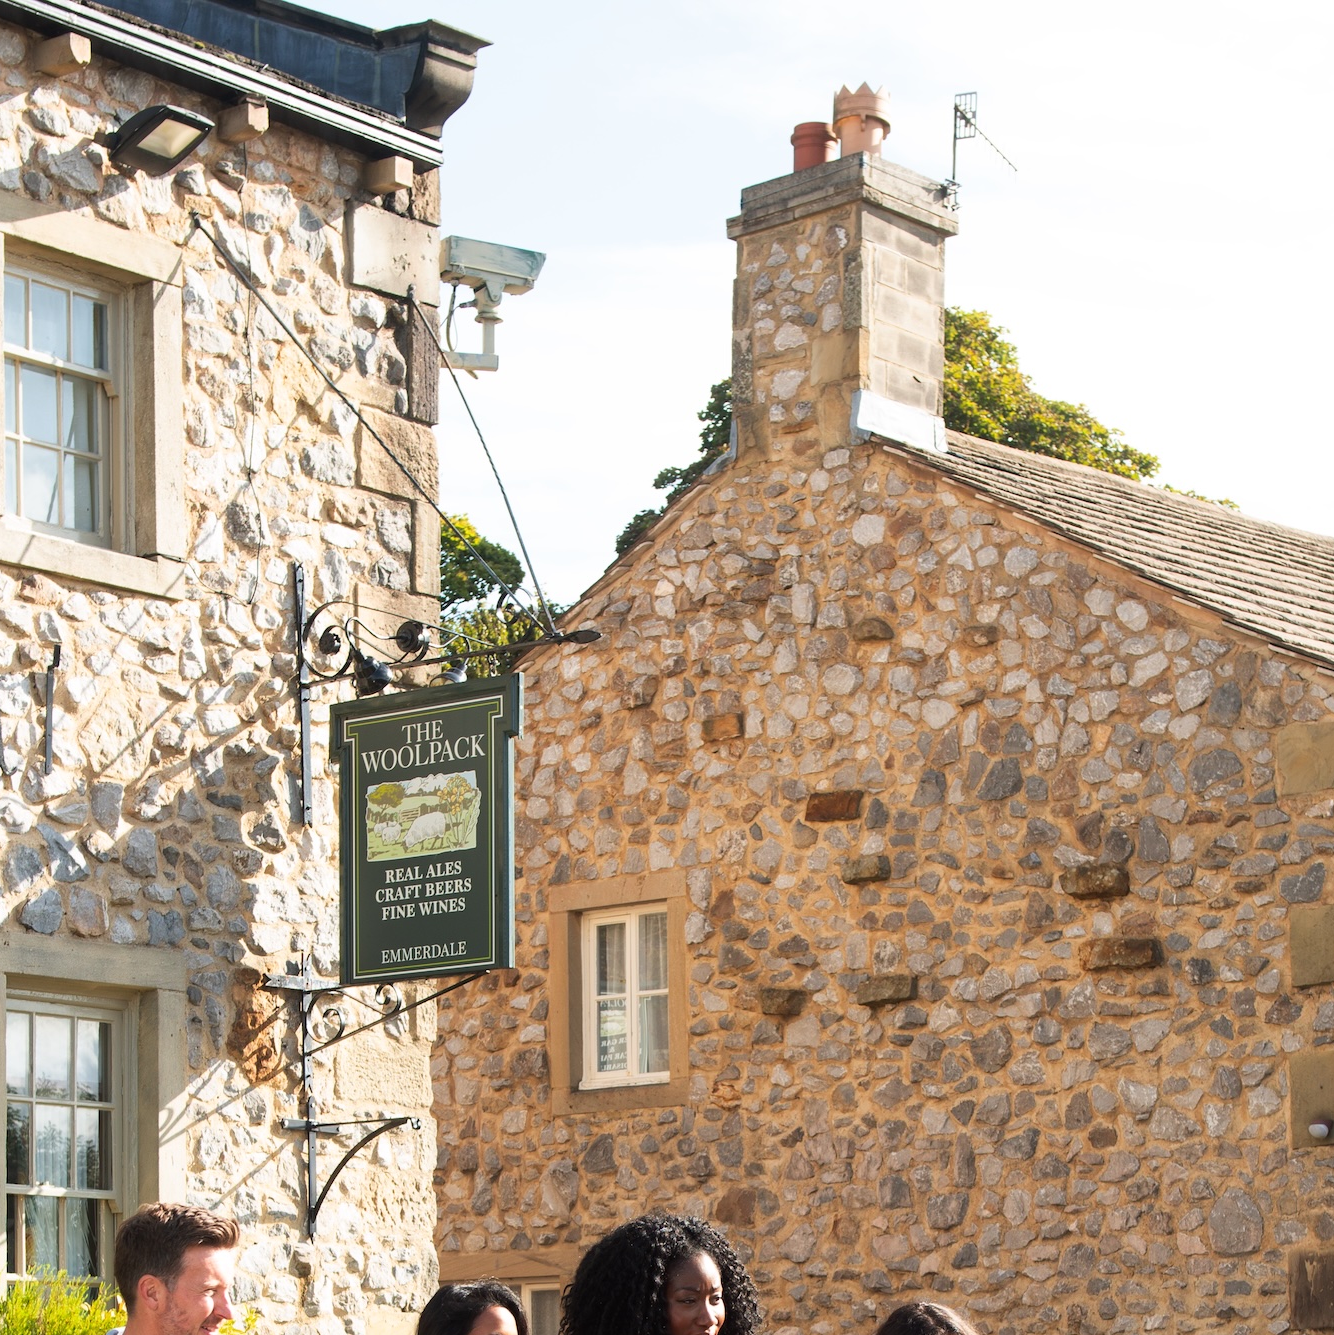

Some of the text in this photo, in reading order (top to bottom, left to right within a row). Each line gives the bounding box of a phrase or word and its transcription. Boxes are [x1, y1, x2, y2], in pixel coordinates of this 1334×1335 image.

[401, 719, 444, 745] THE
[360, 733, 486, 775] WOOLPACK
[384, 860, 462, 884] REAL ALES
[375, 877, 472, 904] CRAFT BEERS
[381, 897, 466, 921] FINE WINES
[381, 940, 467, 965] EMMERDALE
